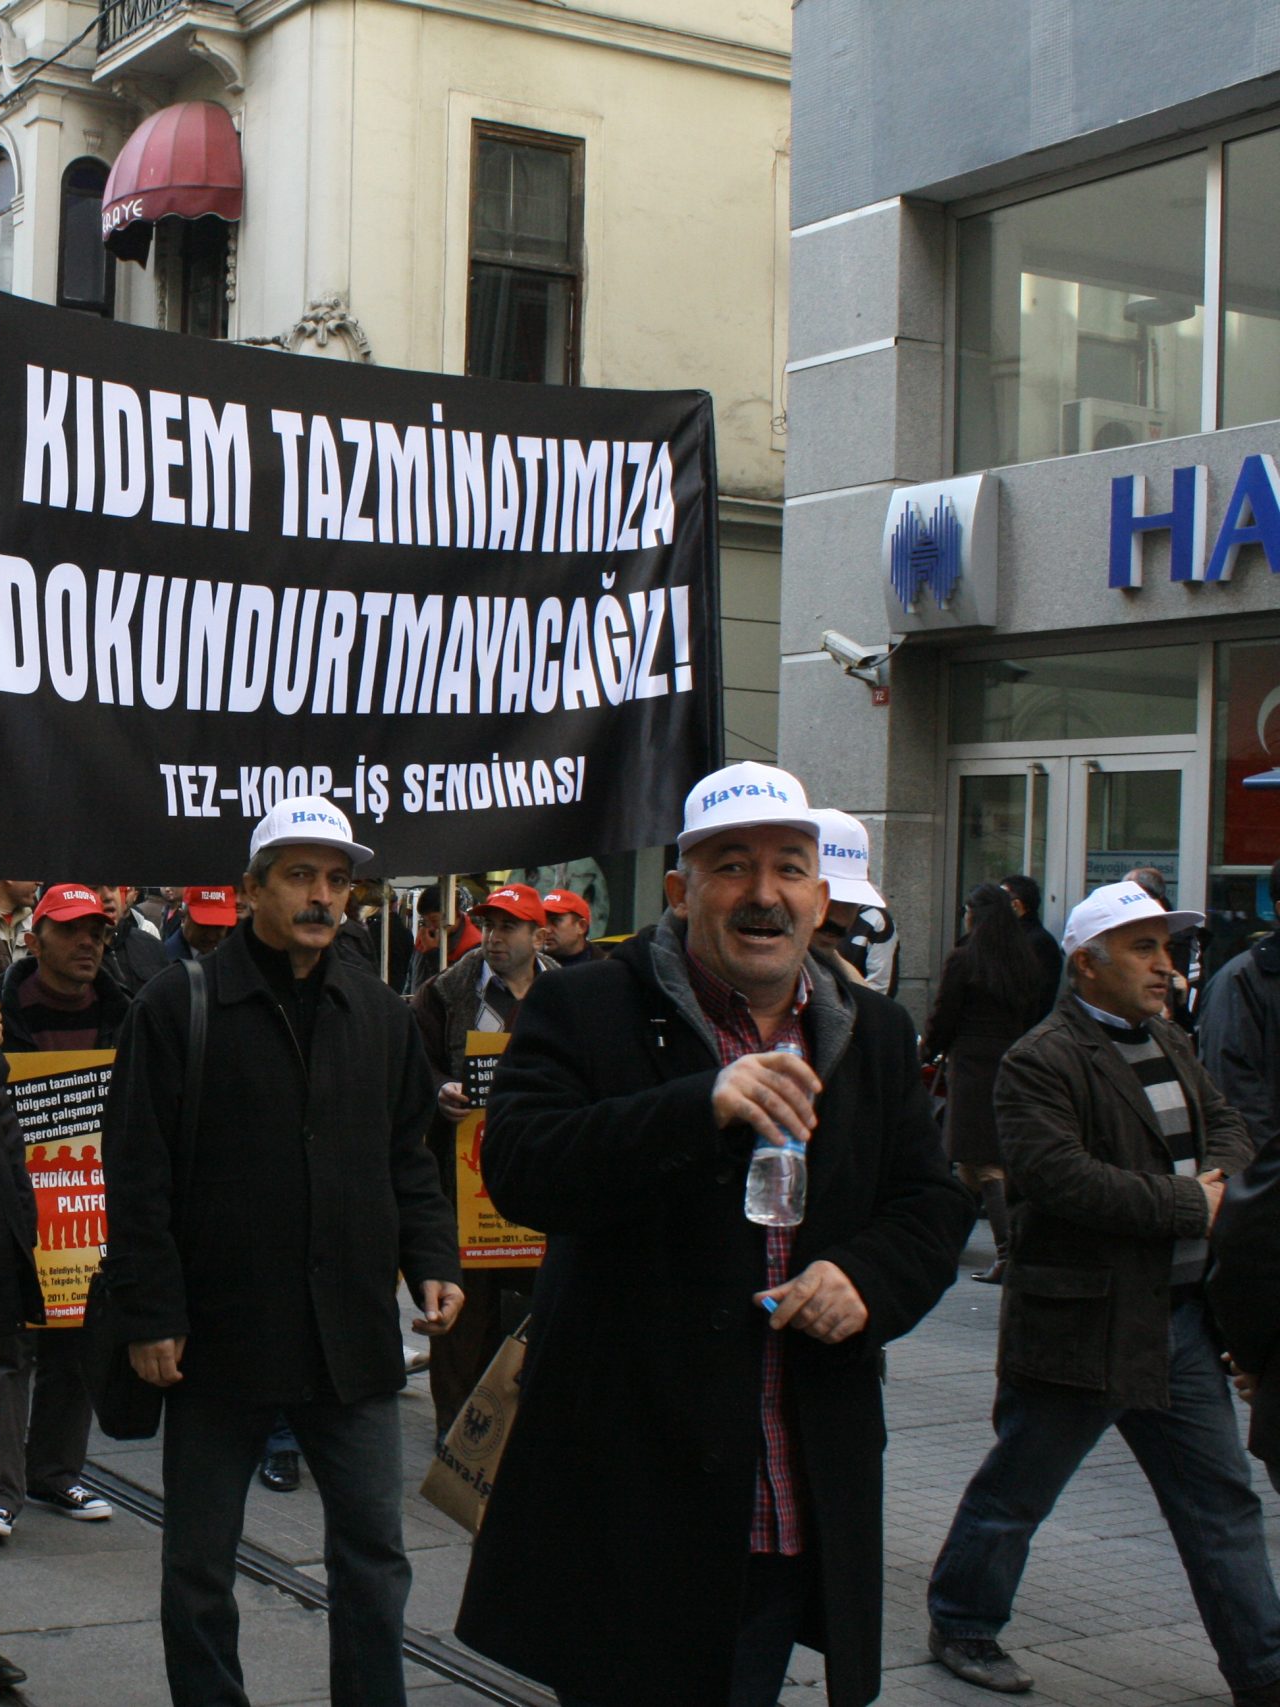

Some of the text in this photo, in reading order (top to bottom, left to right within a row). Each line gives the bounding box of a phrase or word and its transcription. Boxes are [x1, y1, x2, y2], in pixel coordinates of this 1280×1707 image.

[23, 363, 675, 553] KIDEM TAZMİNATIMIZA
[160, 753, 586, 824] TEZ-KOOP-İŞ SENDİKASI
[14, 1080, 47, 1097] kıdem
[49, 1072, 98, 1091] tazminatı
[16, 1092, 61, 1112] bölgesel
[63, 1085, 95, 1104] asgari
[52, 1102, 104, 1123] çalışmaya
[23, 1119, 101, 1144] aşeronlaşmaya
[29, 1168, 88, 1189] ENDİKAL
